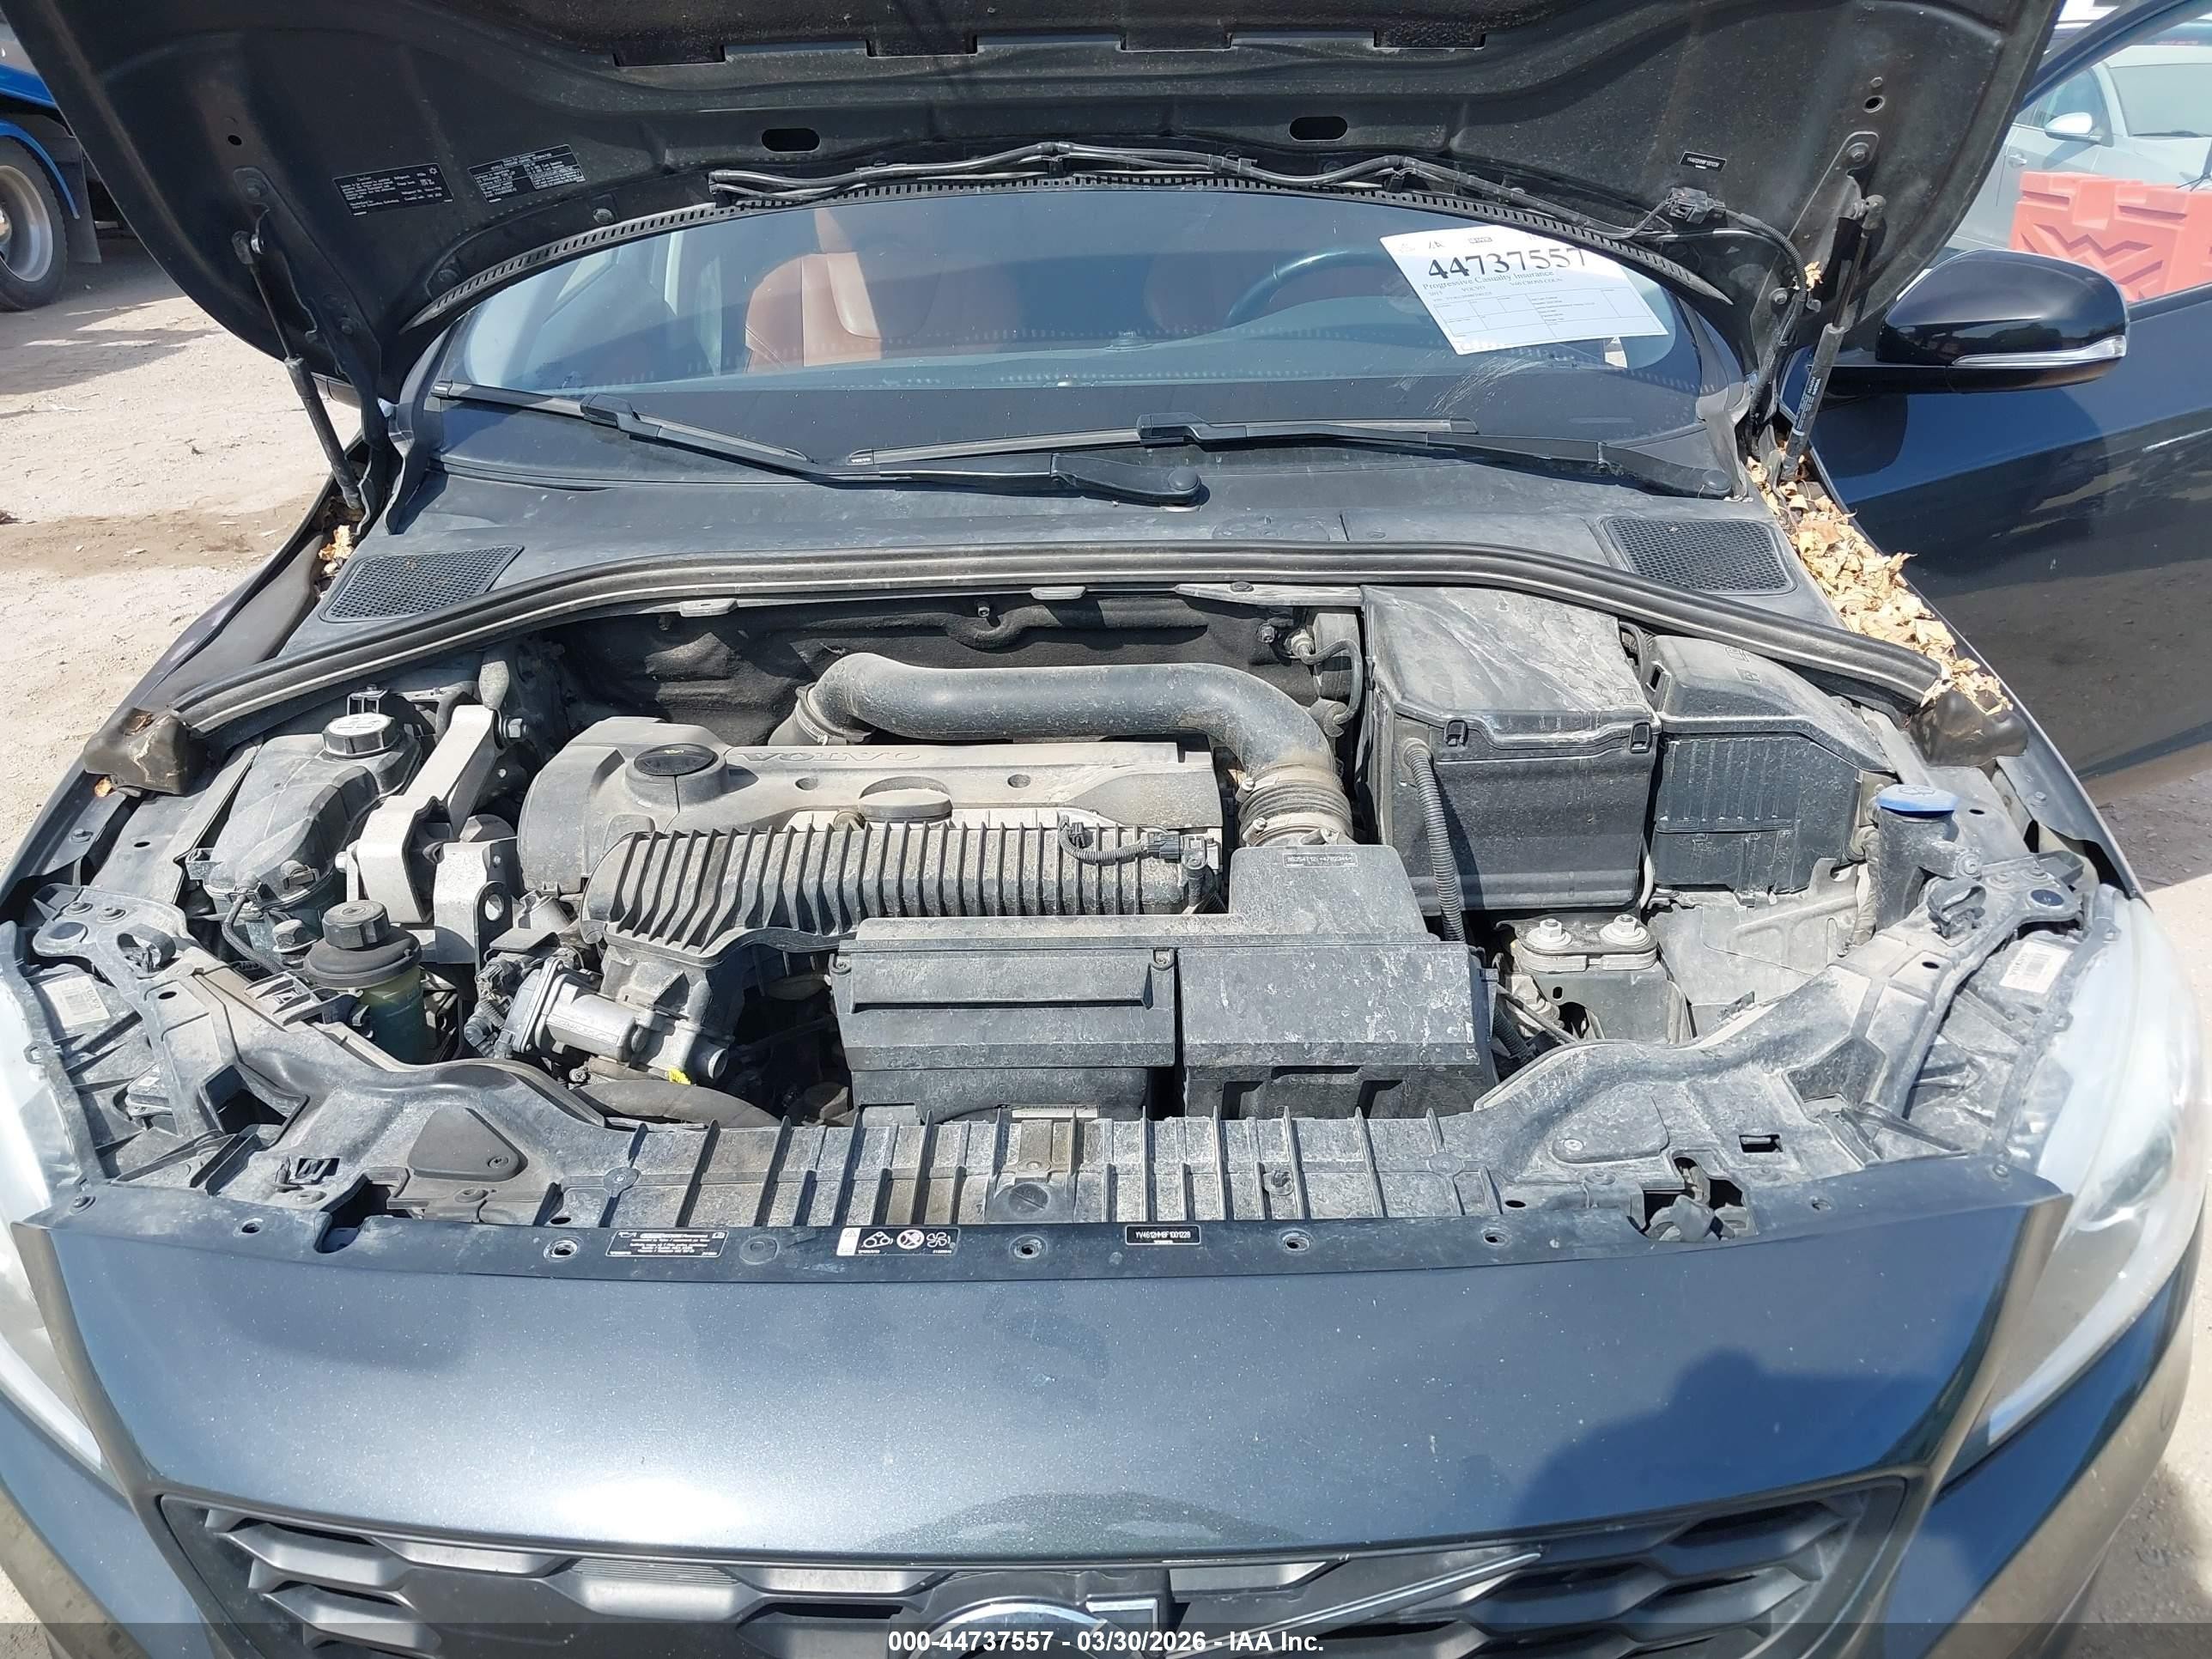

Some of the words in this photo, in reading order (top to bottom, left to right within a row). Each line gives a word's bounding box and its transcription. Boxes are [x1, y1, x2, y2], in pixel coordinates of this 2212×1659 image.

[1429, 247, 1585, 279] 44737557
[1423, 278, 1473, 290] Progressive
[1474, 271, 1511, 283] Casualty
[1512, 270, 1555, 279] Insurance
